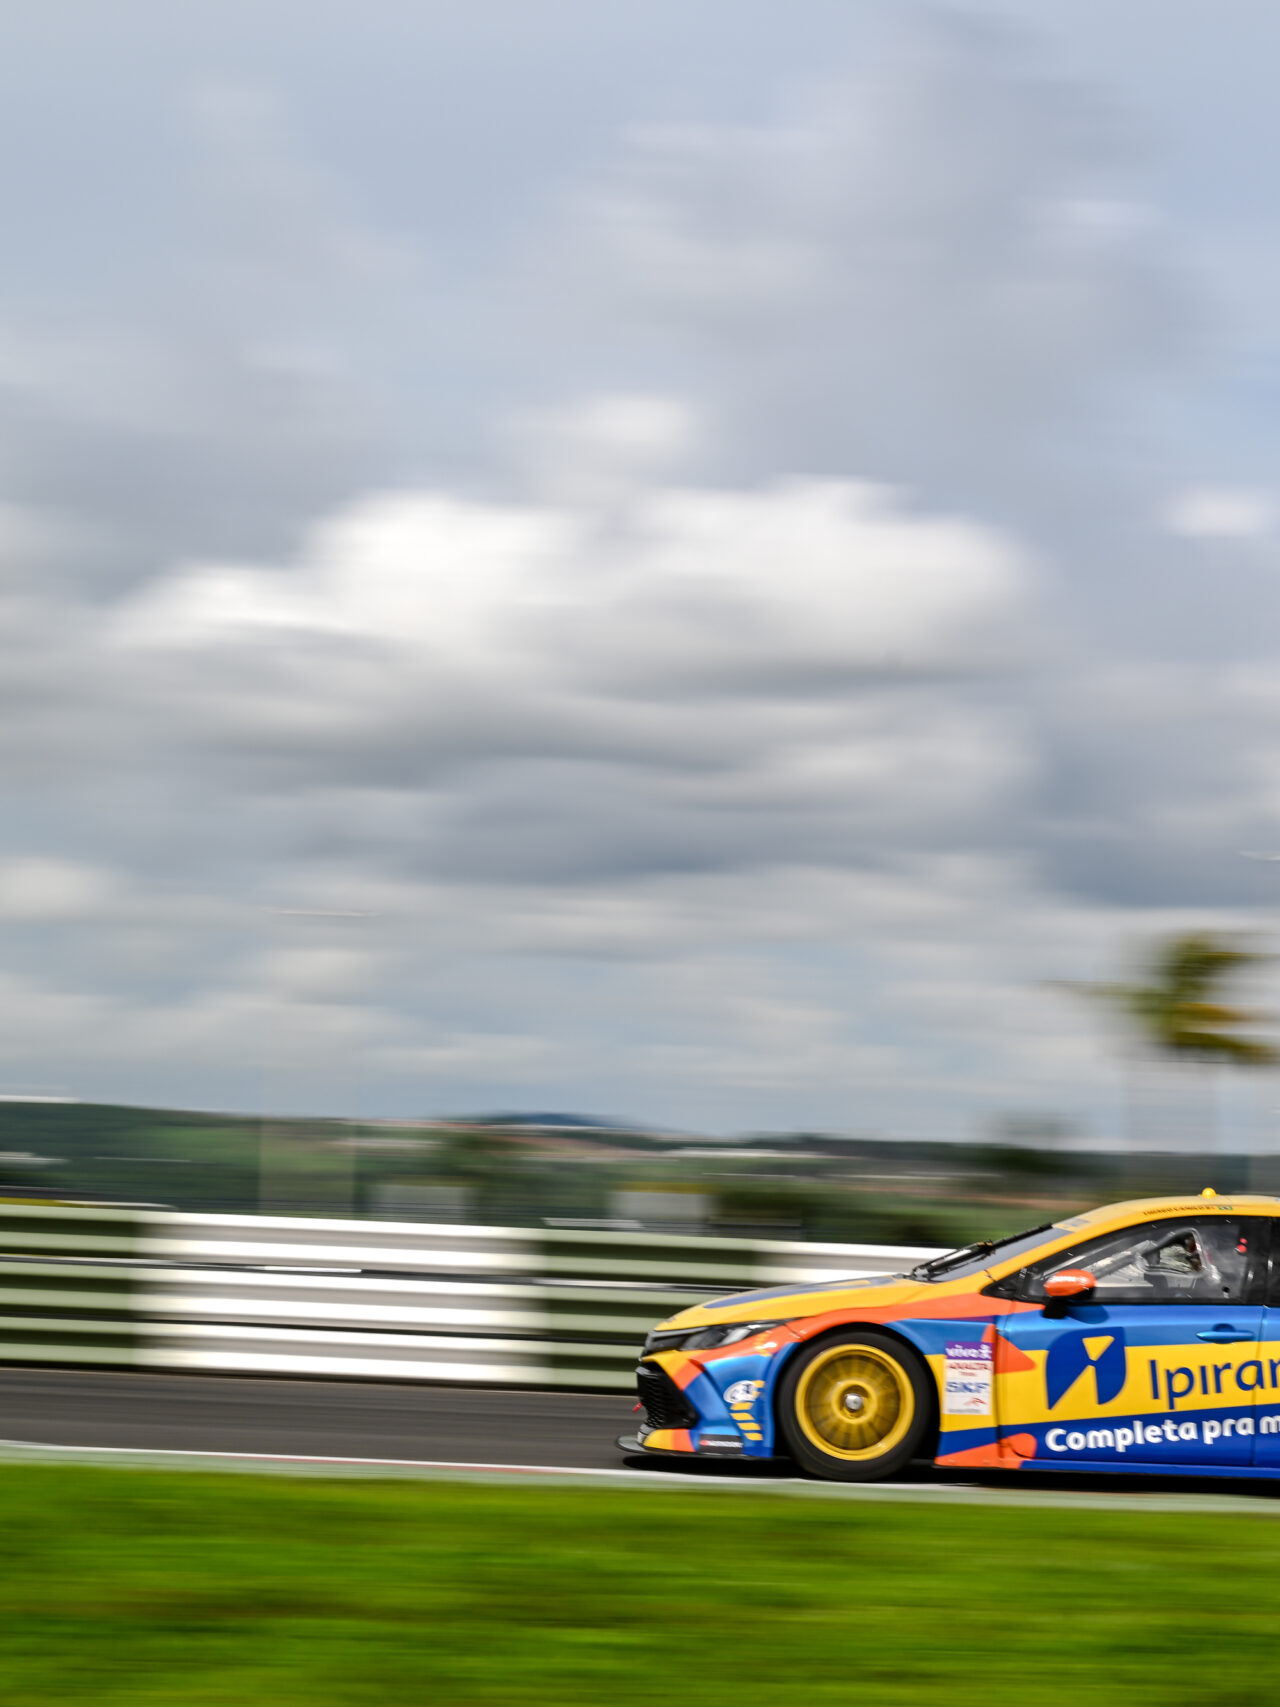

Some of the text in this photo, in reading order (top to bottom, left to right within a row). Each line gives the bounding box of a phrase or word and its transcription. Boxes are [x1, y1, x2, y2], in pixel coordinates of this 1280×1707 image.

[945, 1381, 990, 1393] SKF
[1045, 1420, 1199, 1453] Completa
[1202, 1416, 1255, 1445] pra
